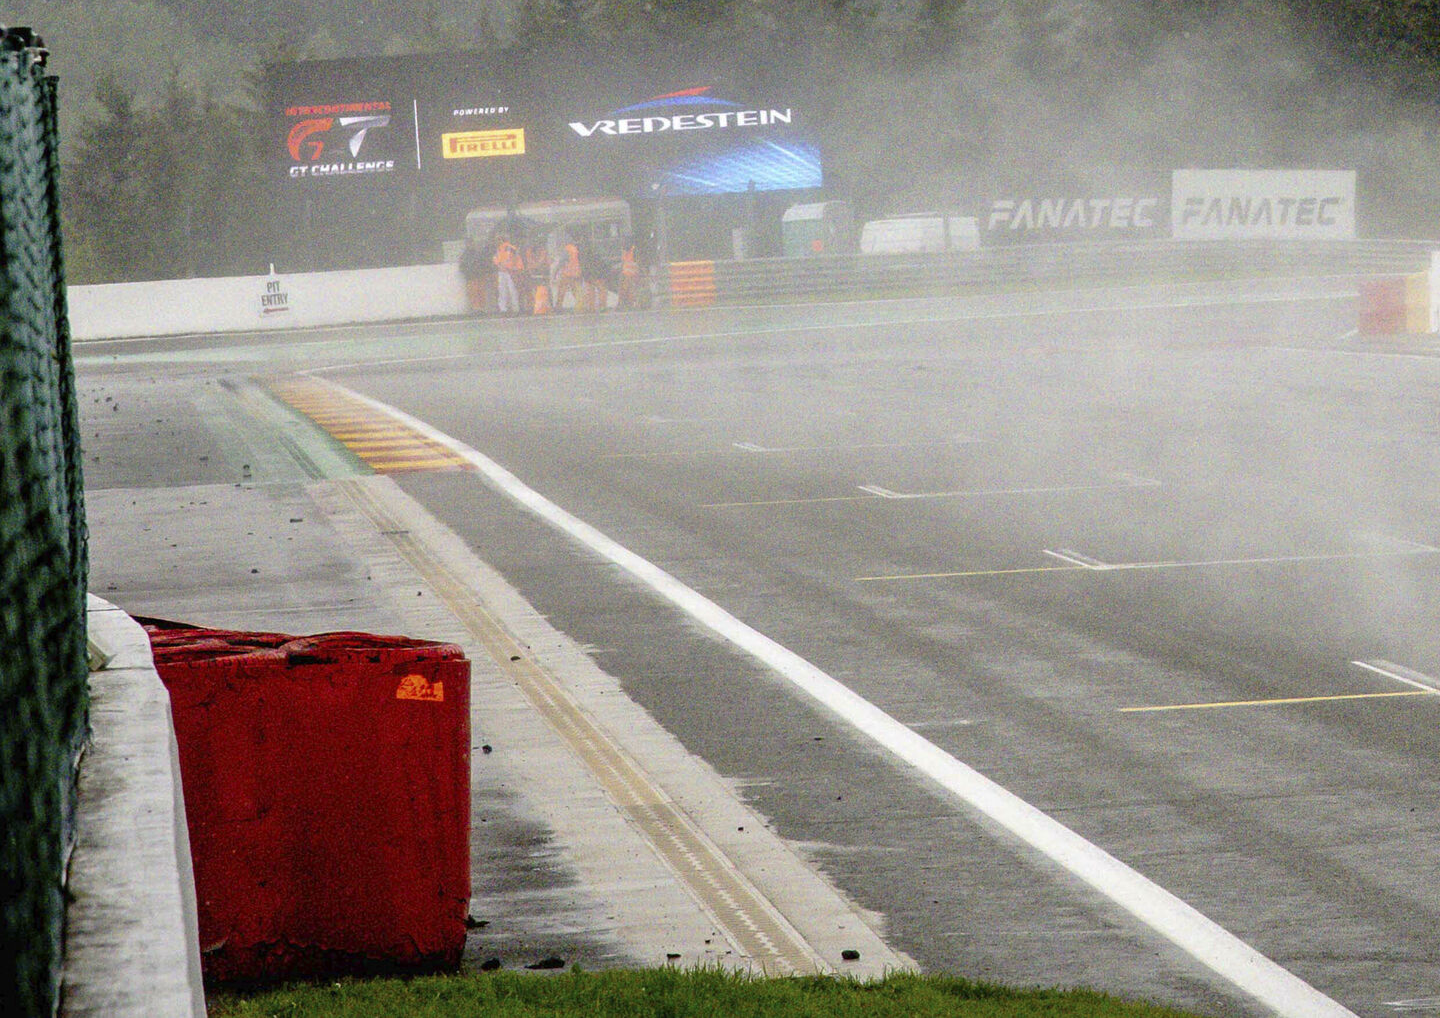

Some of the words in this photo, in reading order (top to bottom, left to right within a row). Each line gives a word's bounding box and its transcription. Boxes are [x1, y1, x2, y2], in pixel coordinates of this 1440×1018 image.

[453, 107, 496, 116] POWERED
[498, 106, 509, 114] BY
[568, 108, 792, 137] VREDESTEIN
[449, 133, 517, 153] PIRELLI
[290, 165, 308, 178] GT
[311, 160, 395, 176] CHALLENGE
[988, 197, 1158, 231] FANATEC
[1181, 195, 1344, 228] FANATEC
[266, 280, 281, 293] PIT
[261, 292, 289, 307] ENTRY
